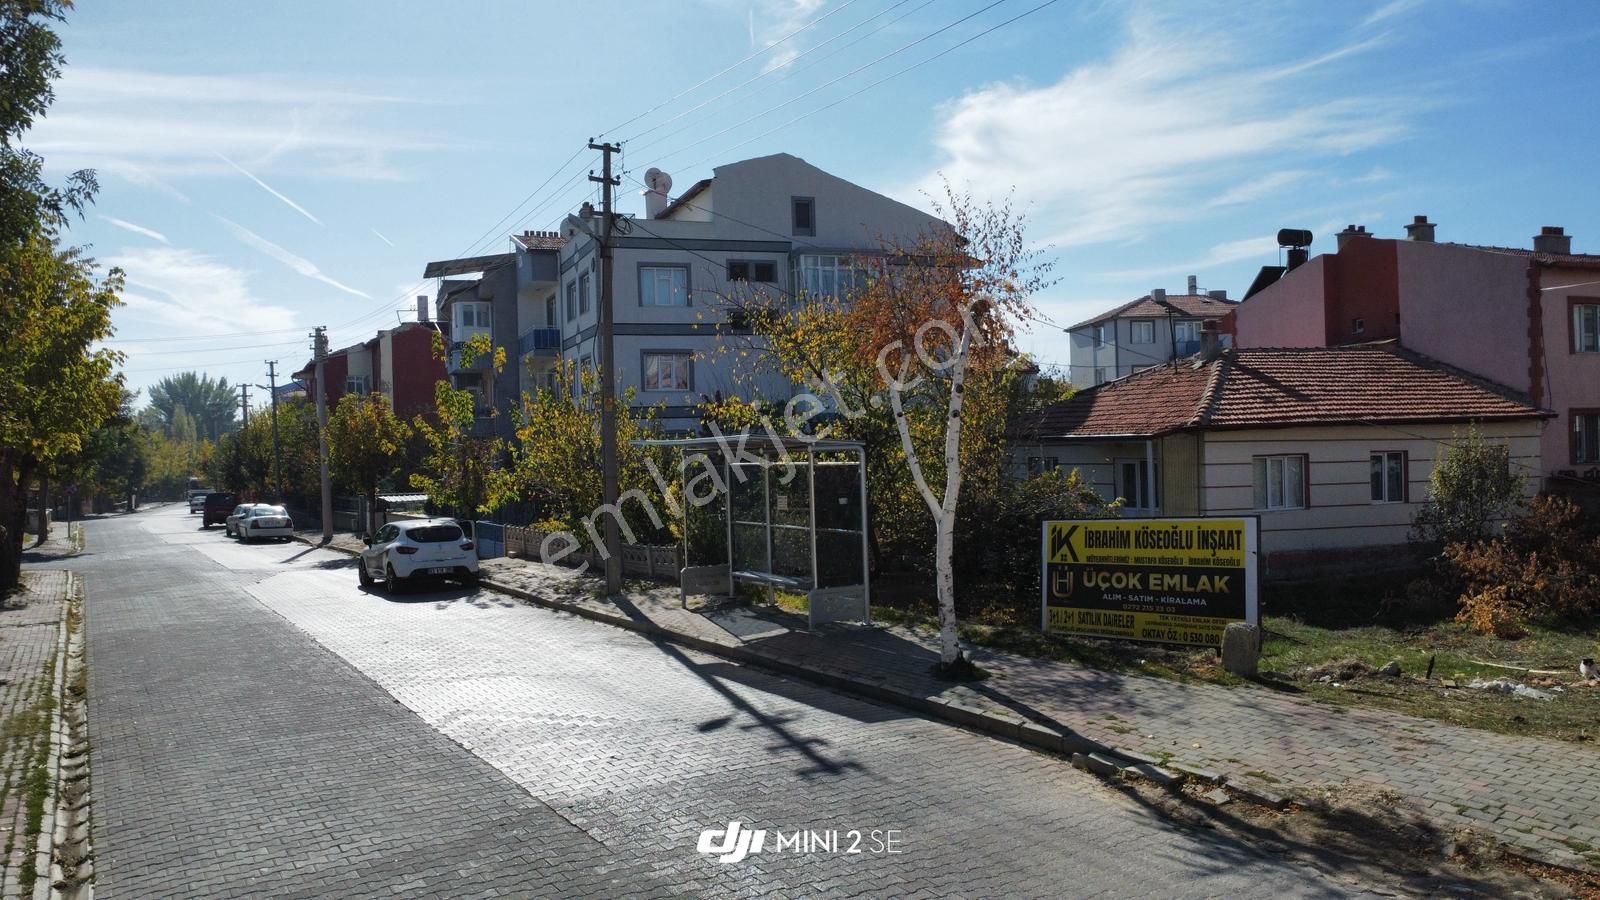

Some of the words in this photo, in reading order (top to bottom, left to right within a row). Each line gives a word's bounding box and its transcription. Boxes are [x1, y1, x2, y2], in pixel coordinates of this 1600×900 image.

[1084, 526, 1131, 550] İBRAHİM
[1134, 525, 1193, 552] KÖSEOĞLU
[1197, 525, 1242, 557] İNŞAAT
[1083, 567, 1144, 592] ÜÇOK
[1149, 573, 1231, 593] EMLAK
[1128, 594, 1153, 603] SATIM
[1160, 595, 1207, 606] KİRALAMA
[1078, 611, 1102, 626] SATILIK
[1103, 613, 1135, 629] DAİRELER
[1142, 627, 1165, 639] OKTAY
[1167, 627, 1177, 640] ÖZ
[1183, 631, 1188, 641] 0
[1190, 632, 1204, 643] 530
[1205, 634, 1220, 644] 080
